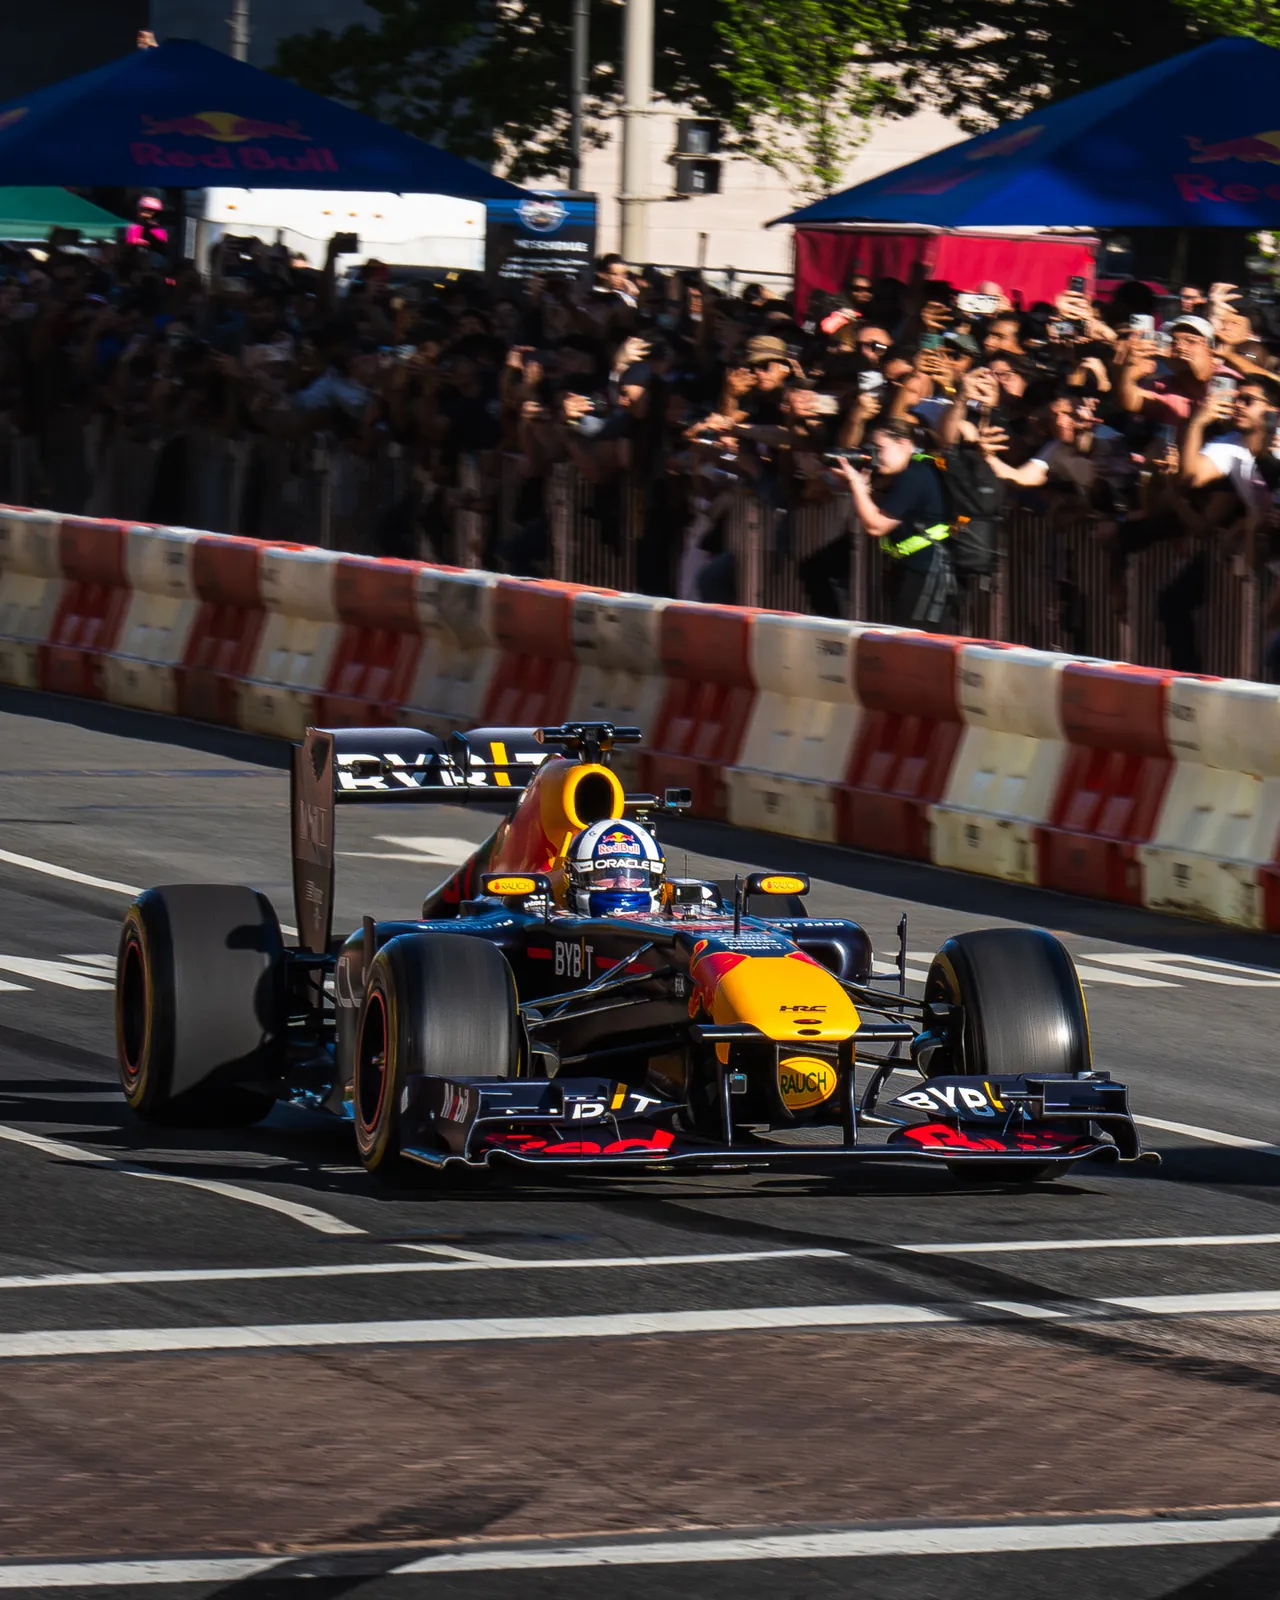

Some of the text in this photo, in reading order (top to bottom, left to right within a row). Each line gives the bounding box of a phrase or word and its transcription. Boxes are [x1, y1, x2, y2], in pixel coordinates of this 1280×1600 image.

[129, 142, 339, 172] Red Bull
[598, 842, 641, 855] Red Bull
[594, 859, 650, 869] ORACLE
[555, 936, 594, 980] BYBIT
[780, 1005, 827, 1013] HRC
[780, 1071, 827, 1095] RAUCH
